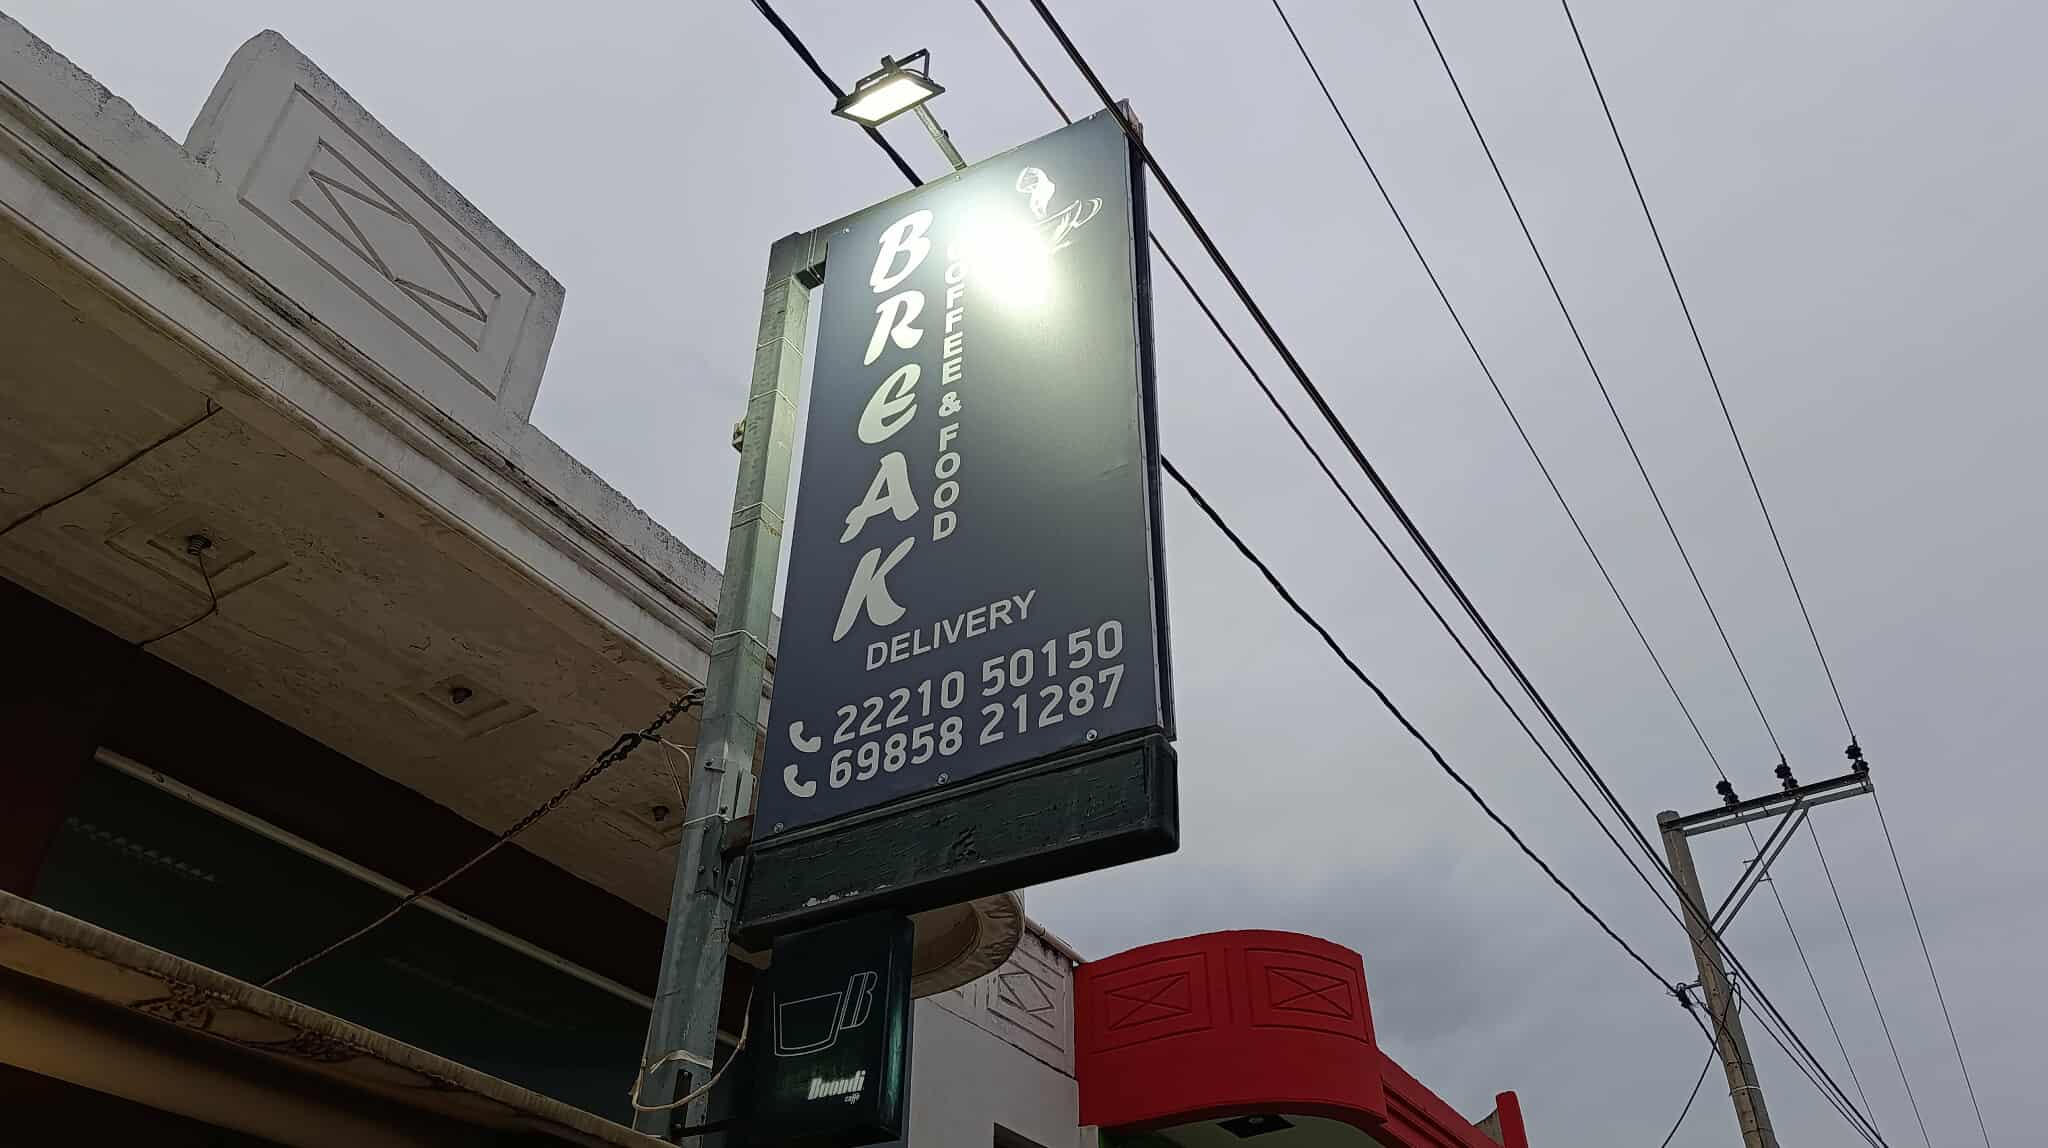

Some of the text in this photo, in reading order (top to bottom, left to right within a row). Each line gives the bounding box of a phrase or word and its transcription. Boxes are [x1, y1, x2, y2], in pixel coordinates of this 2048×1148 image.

[938, 391, 962, 418] &
[932, 422, 961, 542] FOOD
[833, 620, 1124, 744] 22210 50150
[865, 590, 1037, 671] DELIVERY
[829, 664, 1125, 789] 69858 21287
